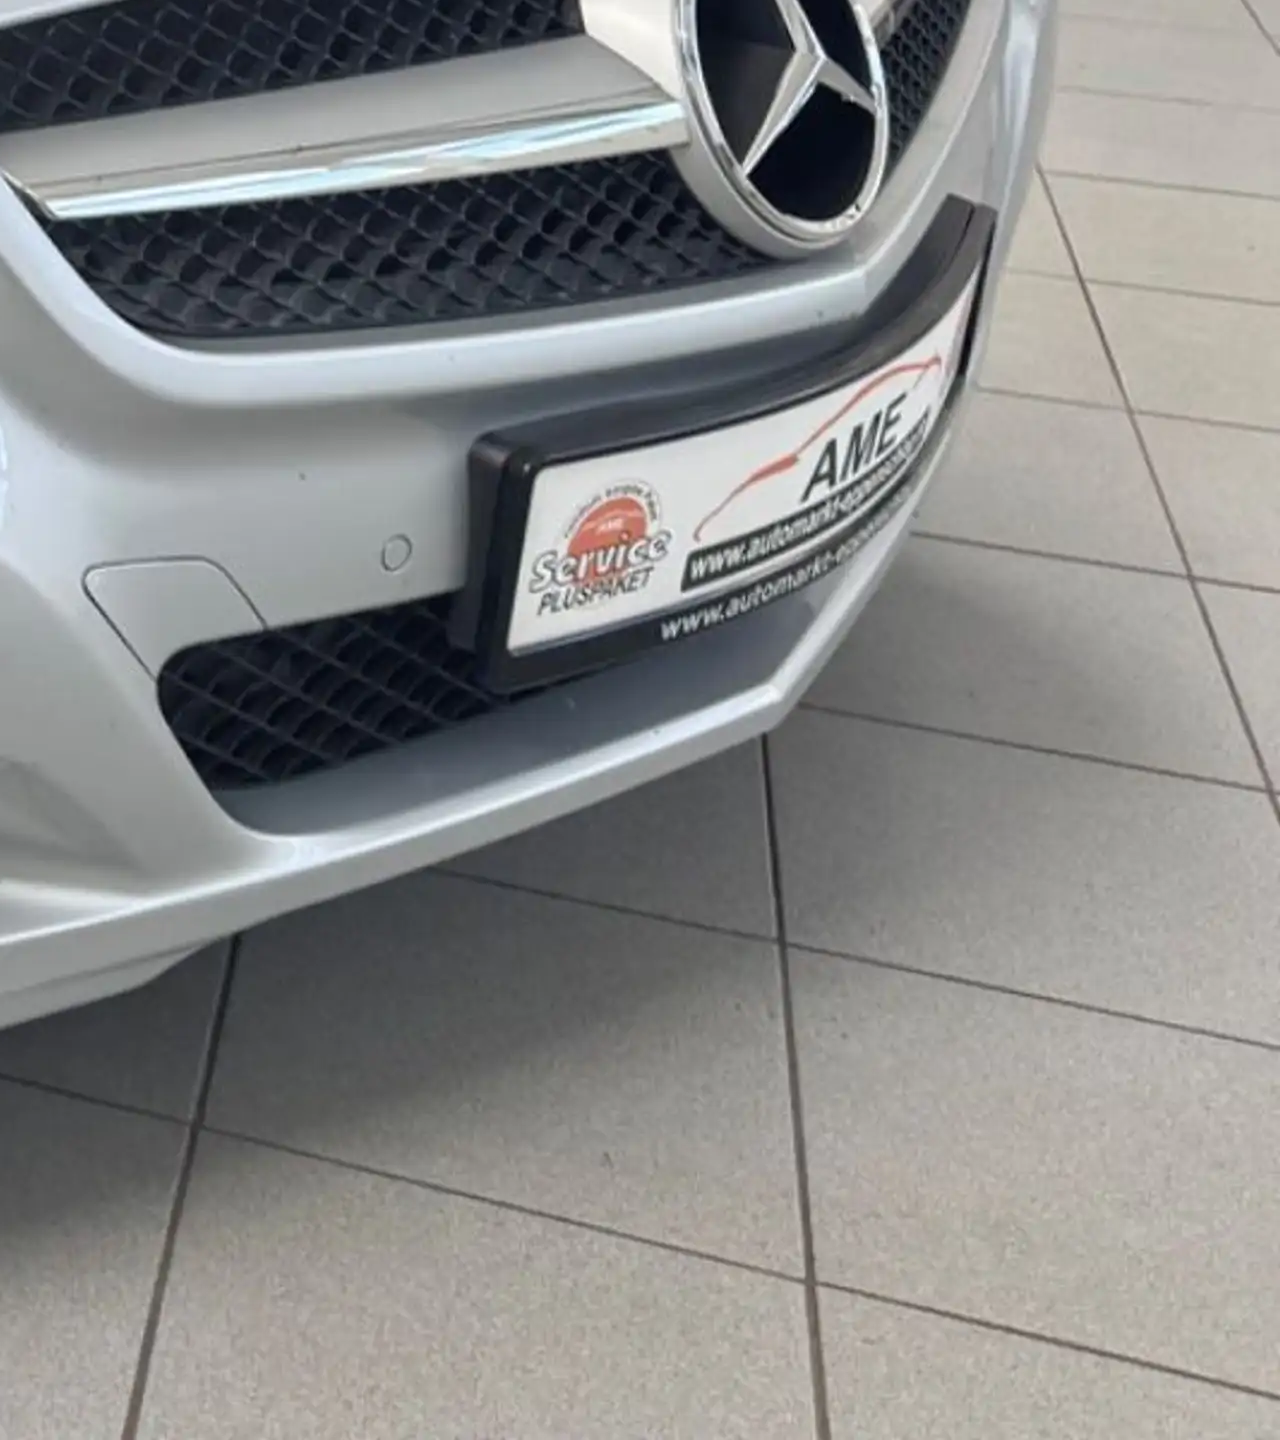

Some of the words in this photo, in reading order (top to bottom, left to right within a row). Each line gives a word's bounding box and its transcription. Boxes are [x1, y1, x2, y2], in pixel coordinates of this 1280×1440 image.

[800, 392, 907, 503] AME
[528, 527, 675, 594] Service
[537, 565, 655, 617] PLUSPAKET
